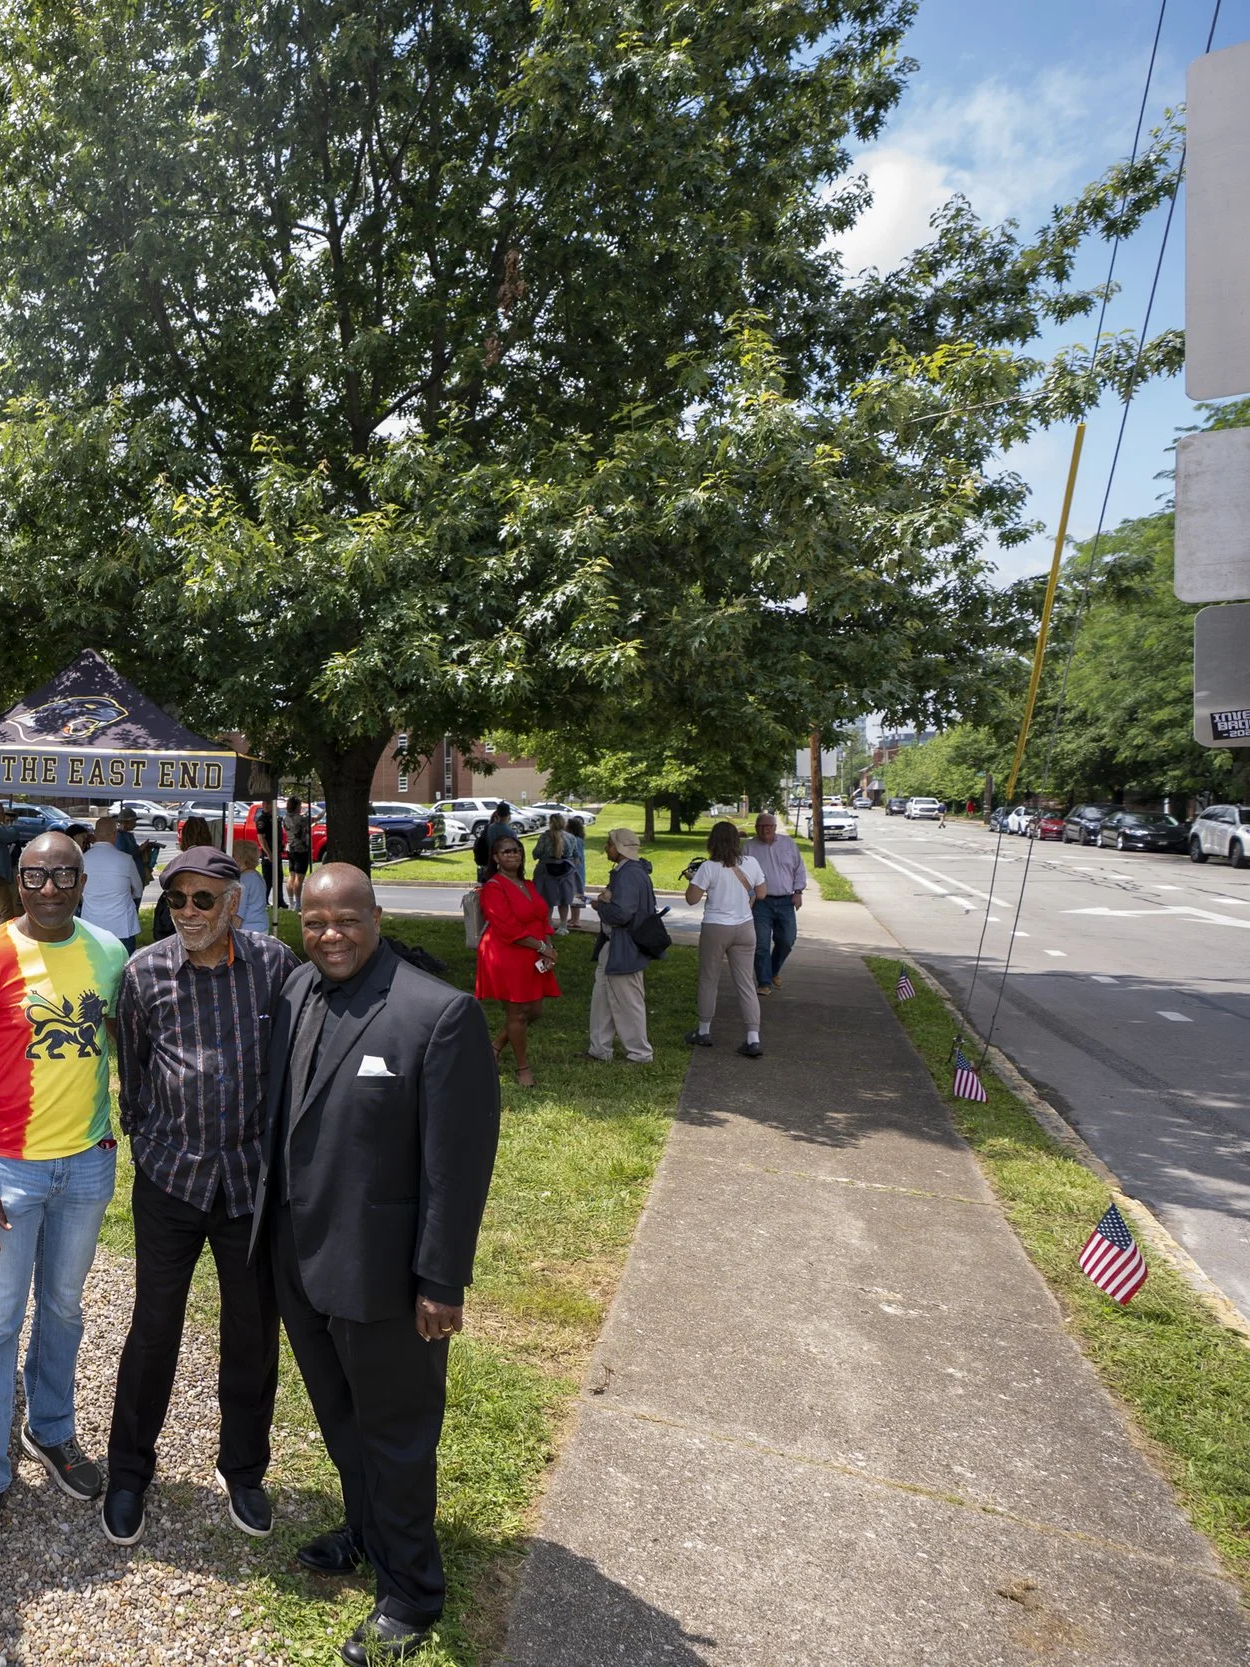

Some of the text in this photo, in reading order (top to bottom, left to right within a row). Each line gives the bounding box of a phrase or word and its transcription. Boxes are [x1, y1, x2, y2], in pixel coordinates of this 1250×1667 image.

[1, 754, 58, 784] THE
[68, 756, 148, 788] EAST
[158, 759, 224, 791] END
